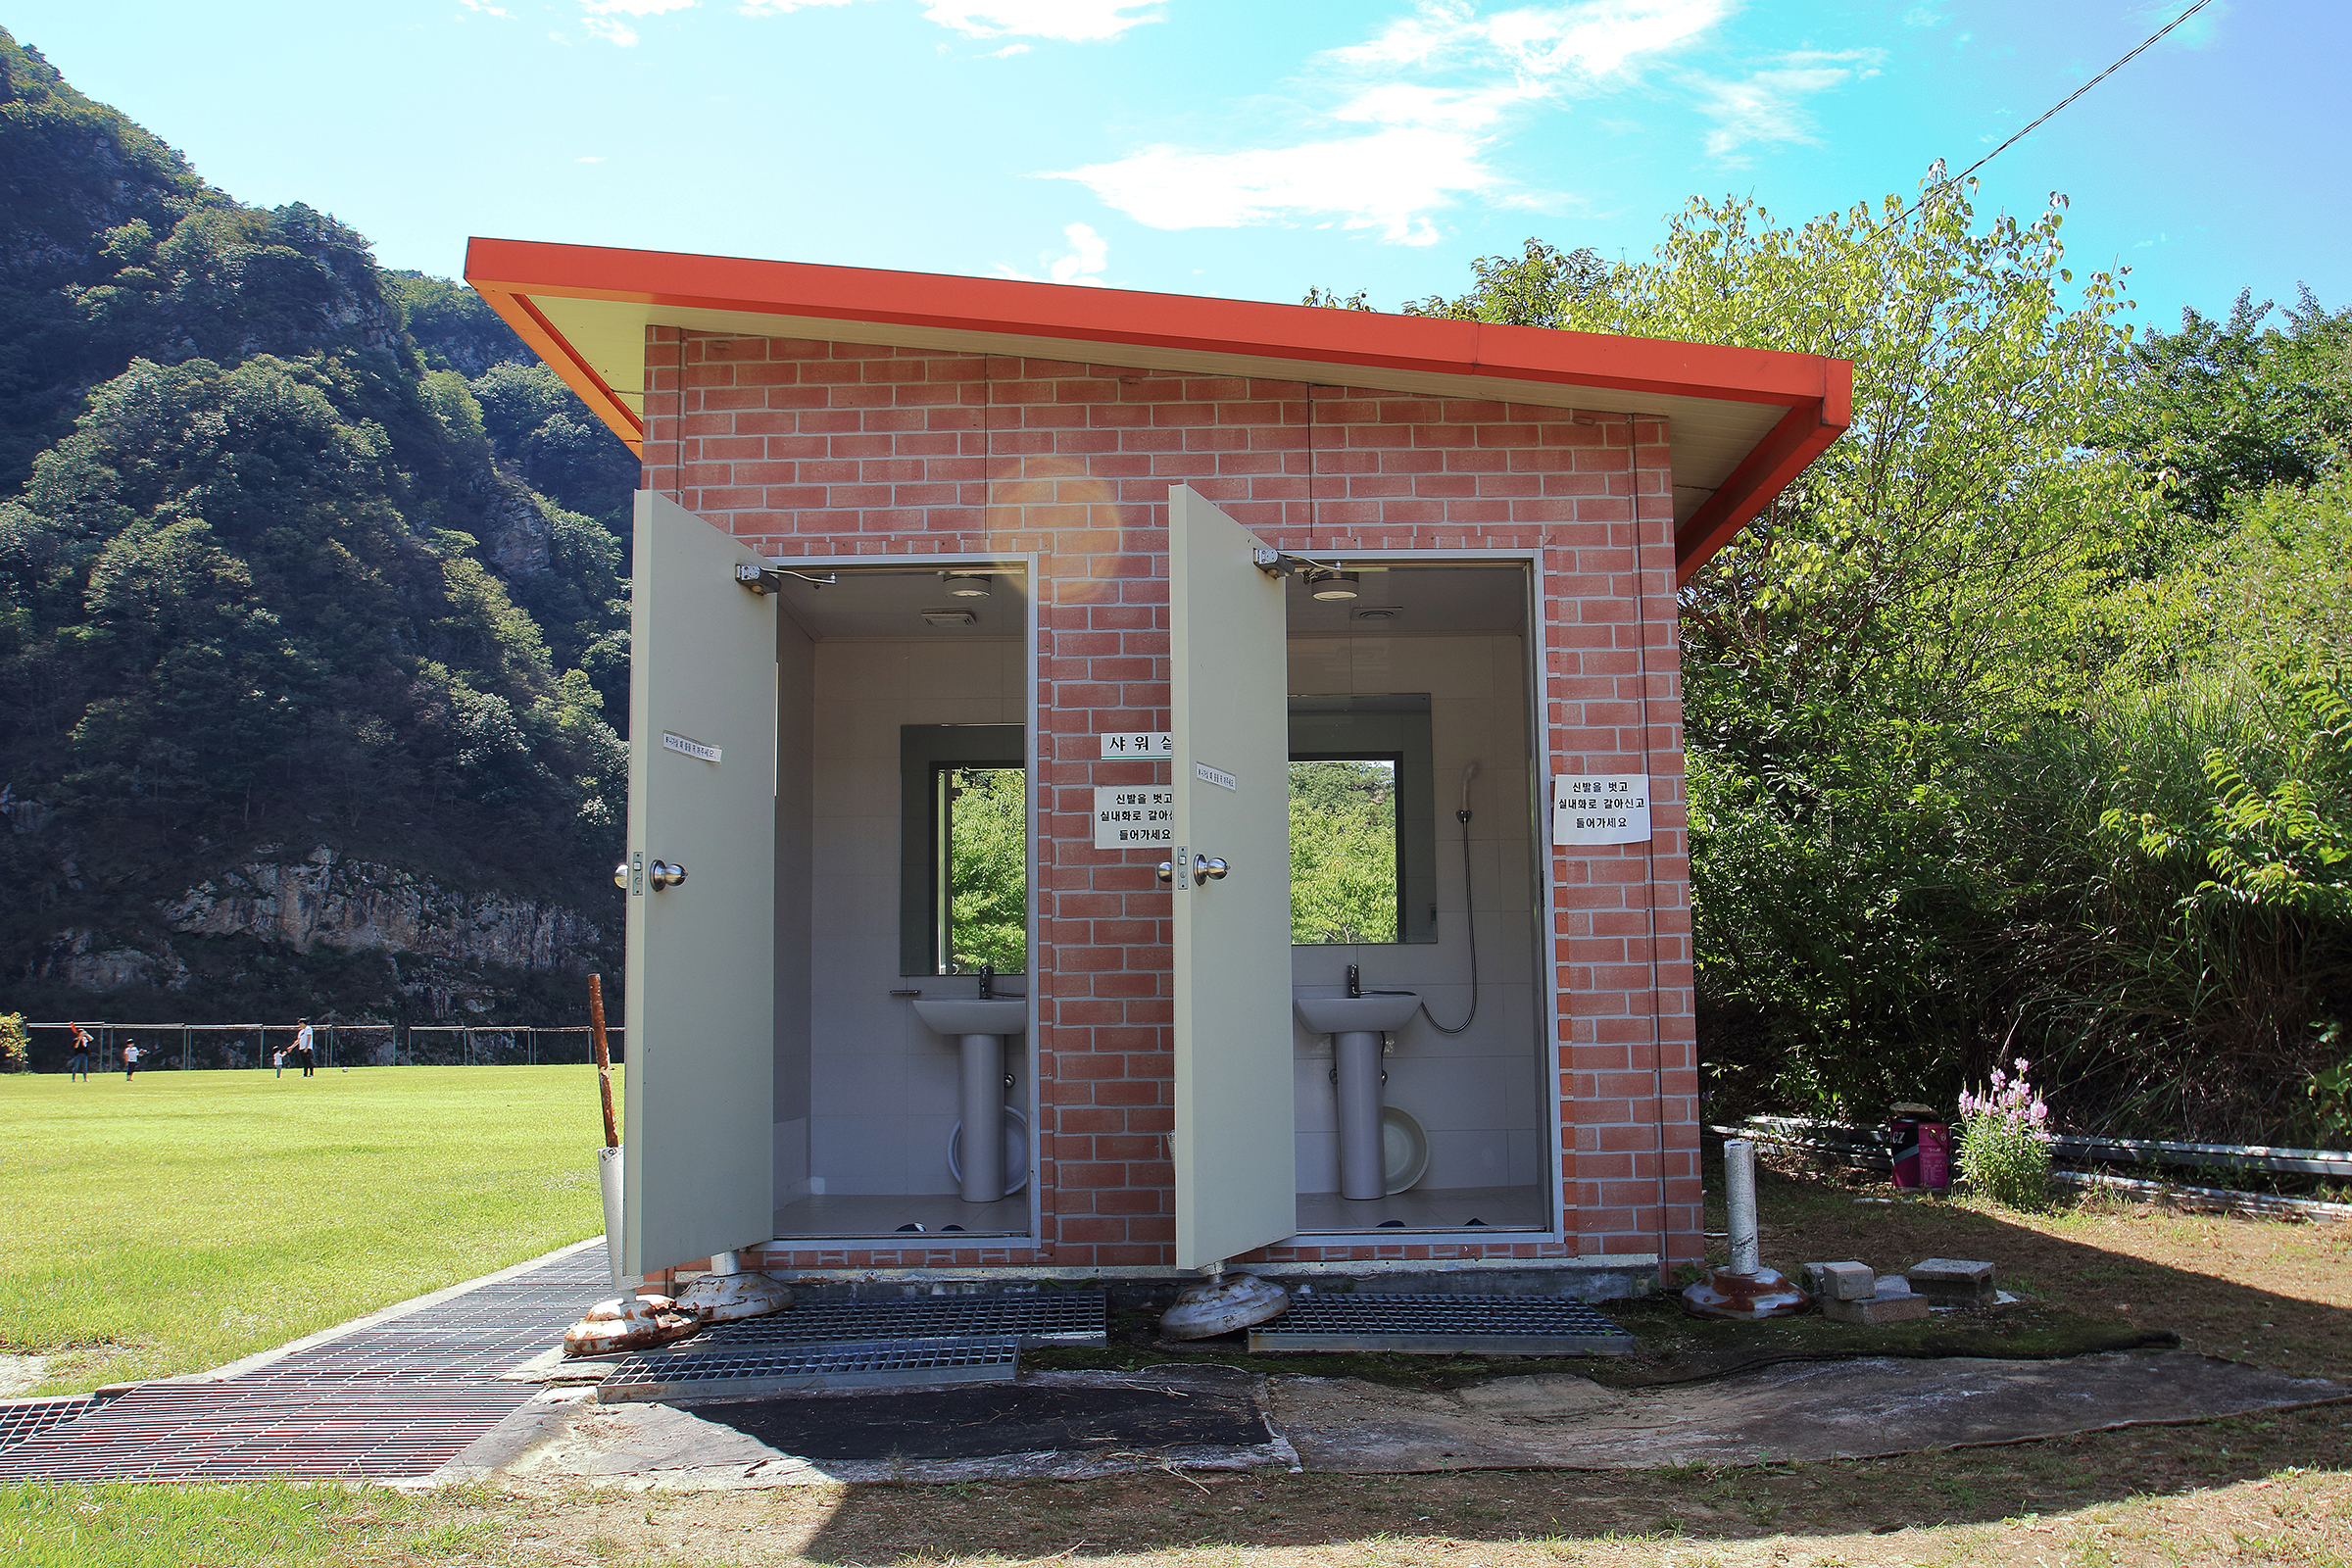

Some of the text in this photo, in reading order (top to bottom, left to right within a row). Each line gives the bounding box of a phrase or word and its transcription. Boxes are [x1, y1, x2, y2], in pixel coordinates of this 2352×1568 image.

[1572, 781, 1629, 793] 신발을 벗고
[1115, 793, 1172, 805] 신발을 벗고
[1558, 798, 1645, 809] 실내화로 갈아신고
[1100, 809, 1142, 821] 실내화로
[1576, 817, 1628, 829] 들어가세요
[1119, 828, 1171, 841] 들어가세요
